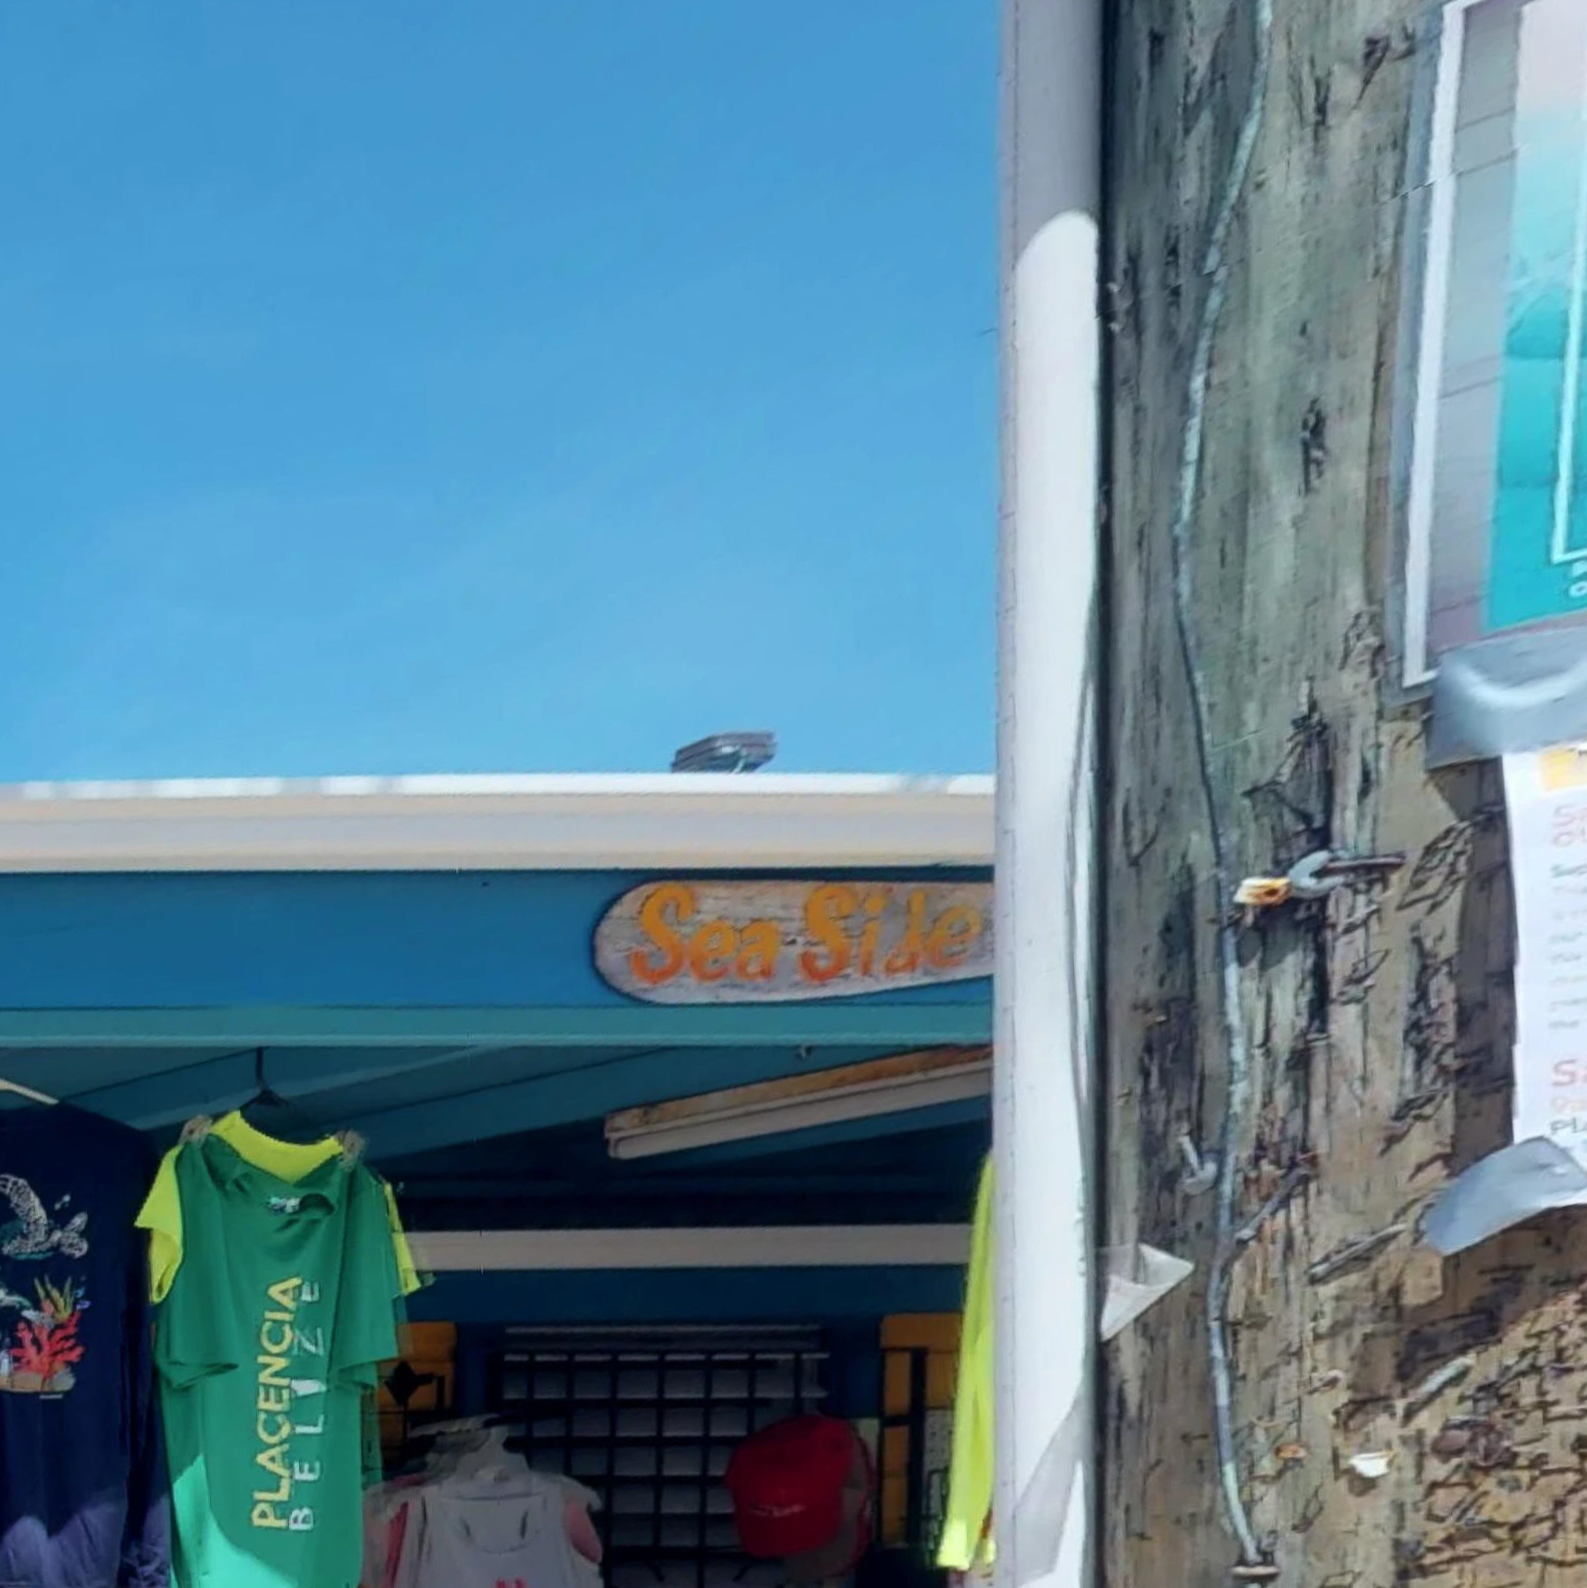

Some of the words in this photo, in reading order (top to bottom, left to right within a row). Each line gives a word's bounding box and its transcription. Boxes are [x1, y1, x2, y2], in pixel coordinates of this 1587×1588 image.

[629, 882, 783, 986] Sea
[796, 882, 983, 985] Side
[251, 1274, 304, 1531] PLACENCIA
[288, 1279, 329, 1533] BELIZE
